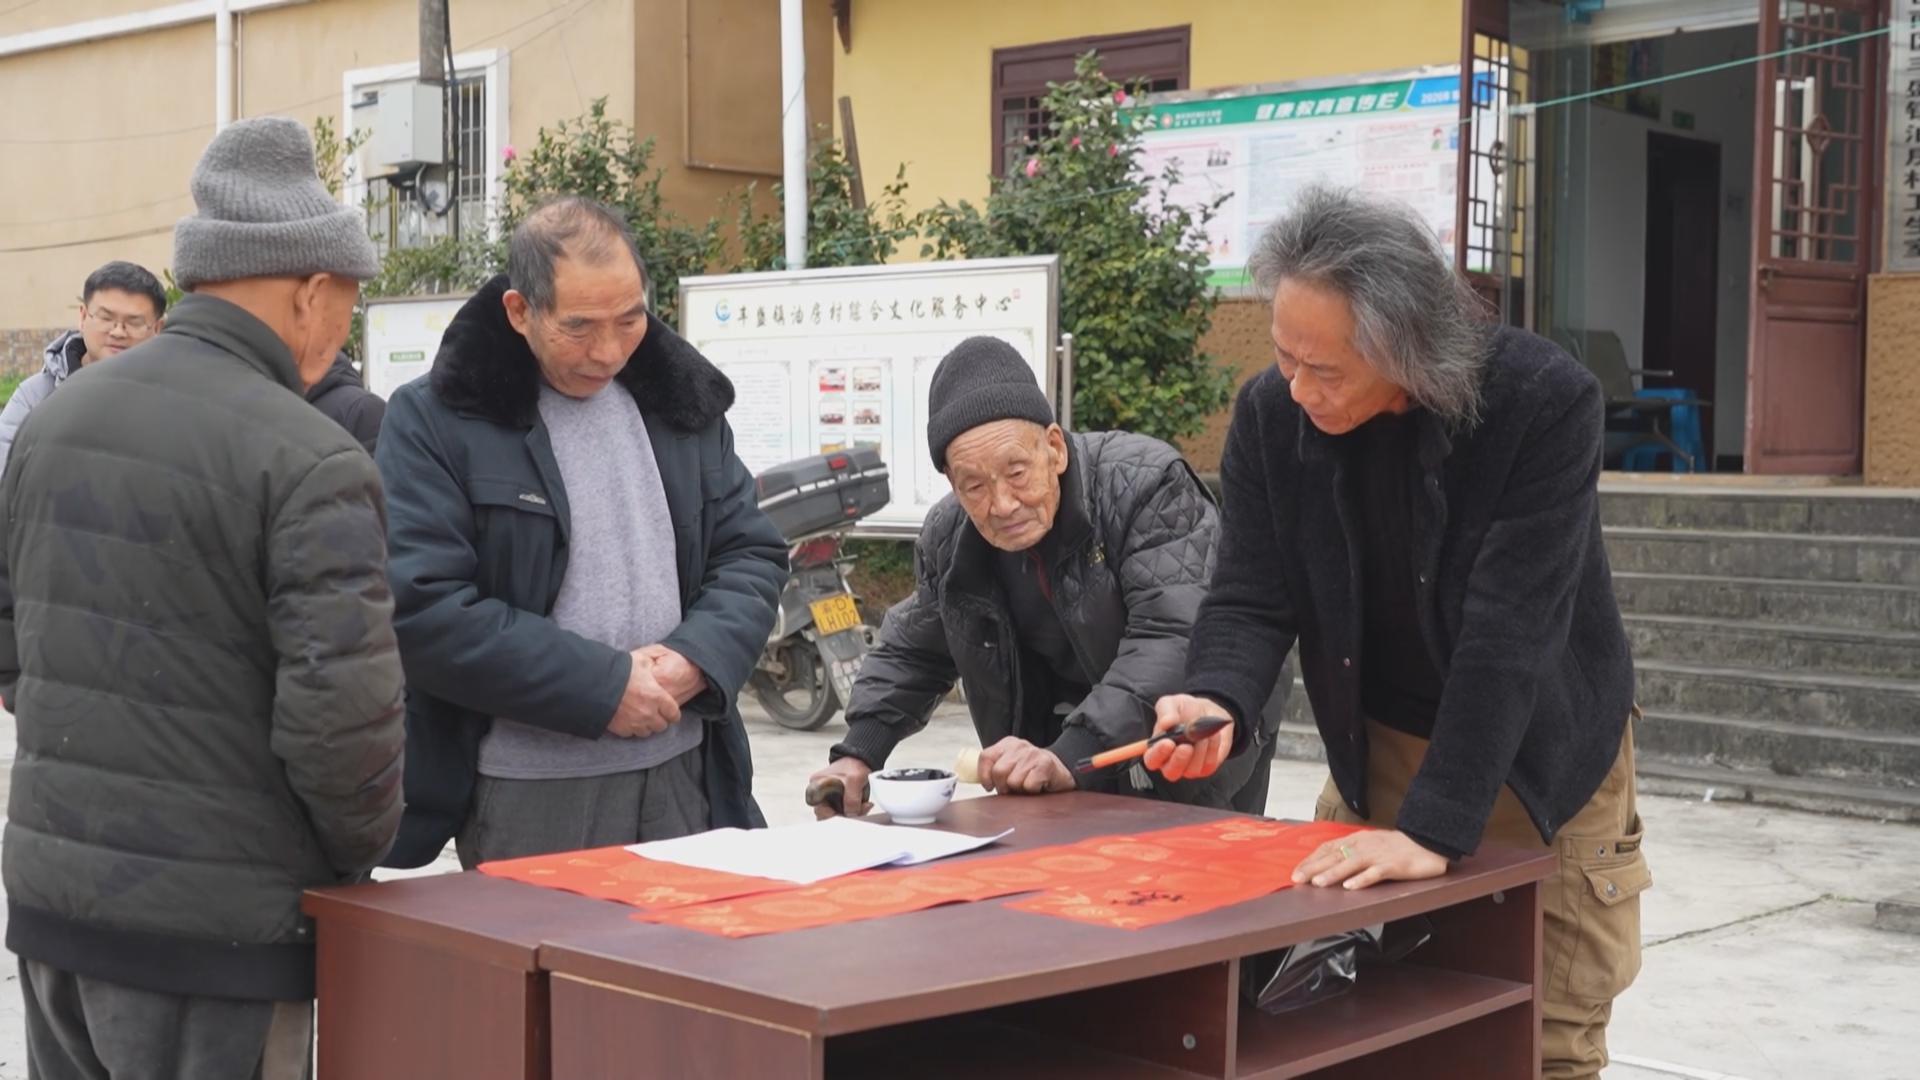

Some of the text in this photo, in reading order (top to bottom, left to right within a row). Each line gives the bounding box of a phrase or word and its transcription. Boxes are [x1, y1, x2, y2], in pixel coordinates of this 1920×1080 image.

[1254, 91, 1400, 121] 健康教育宣传栏
